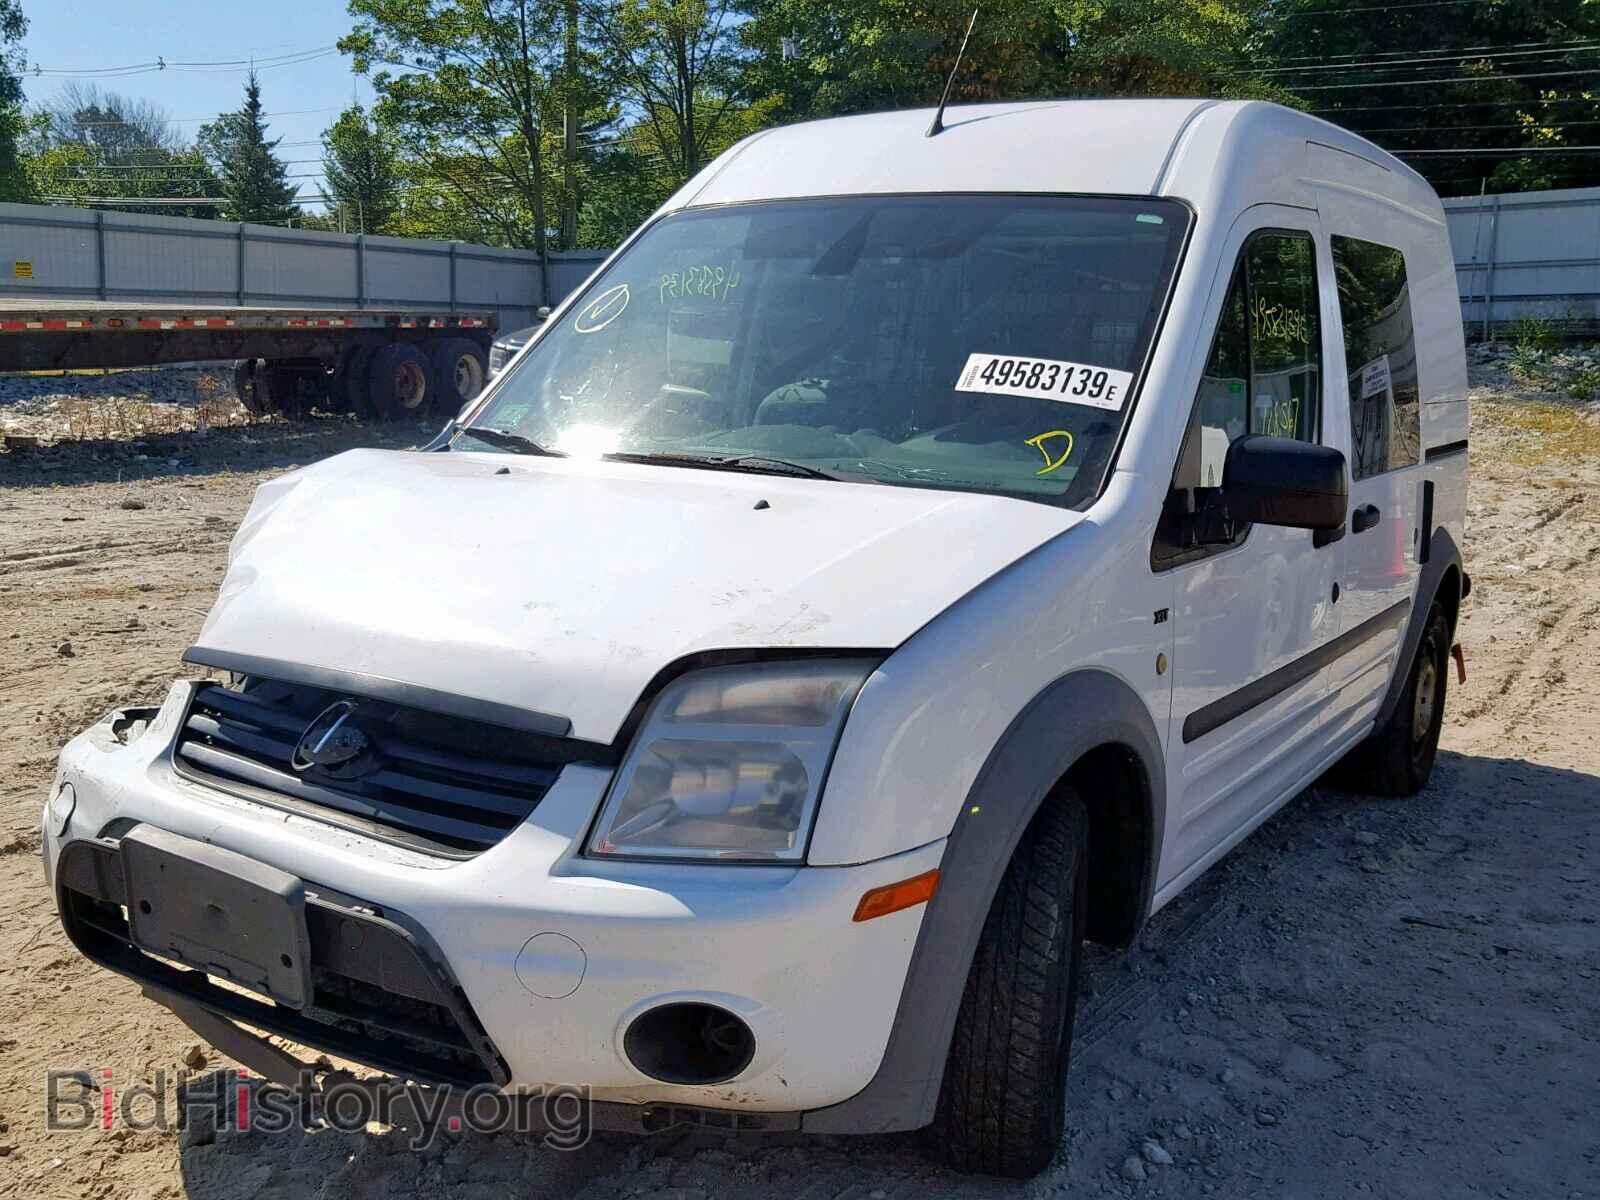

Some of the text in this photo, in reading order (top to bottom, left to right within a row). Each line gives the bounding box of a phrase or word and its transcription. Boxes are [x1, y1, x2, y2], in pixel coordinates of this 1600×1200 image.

[980, 358, 1109, 398] 49583139
[1105, 385, 1118, 401] E
[1024, 430, 1073, 475] D
